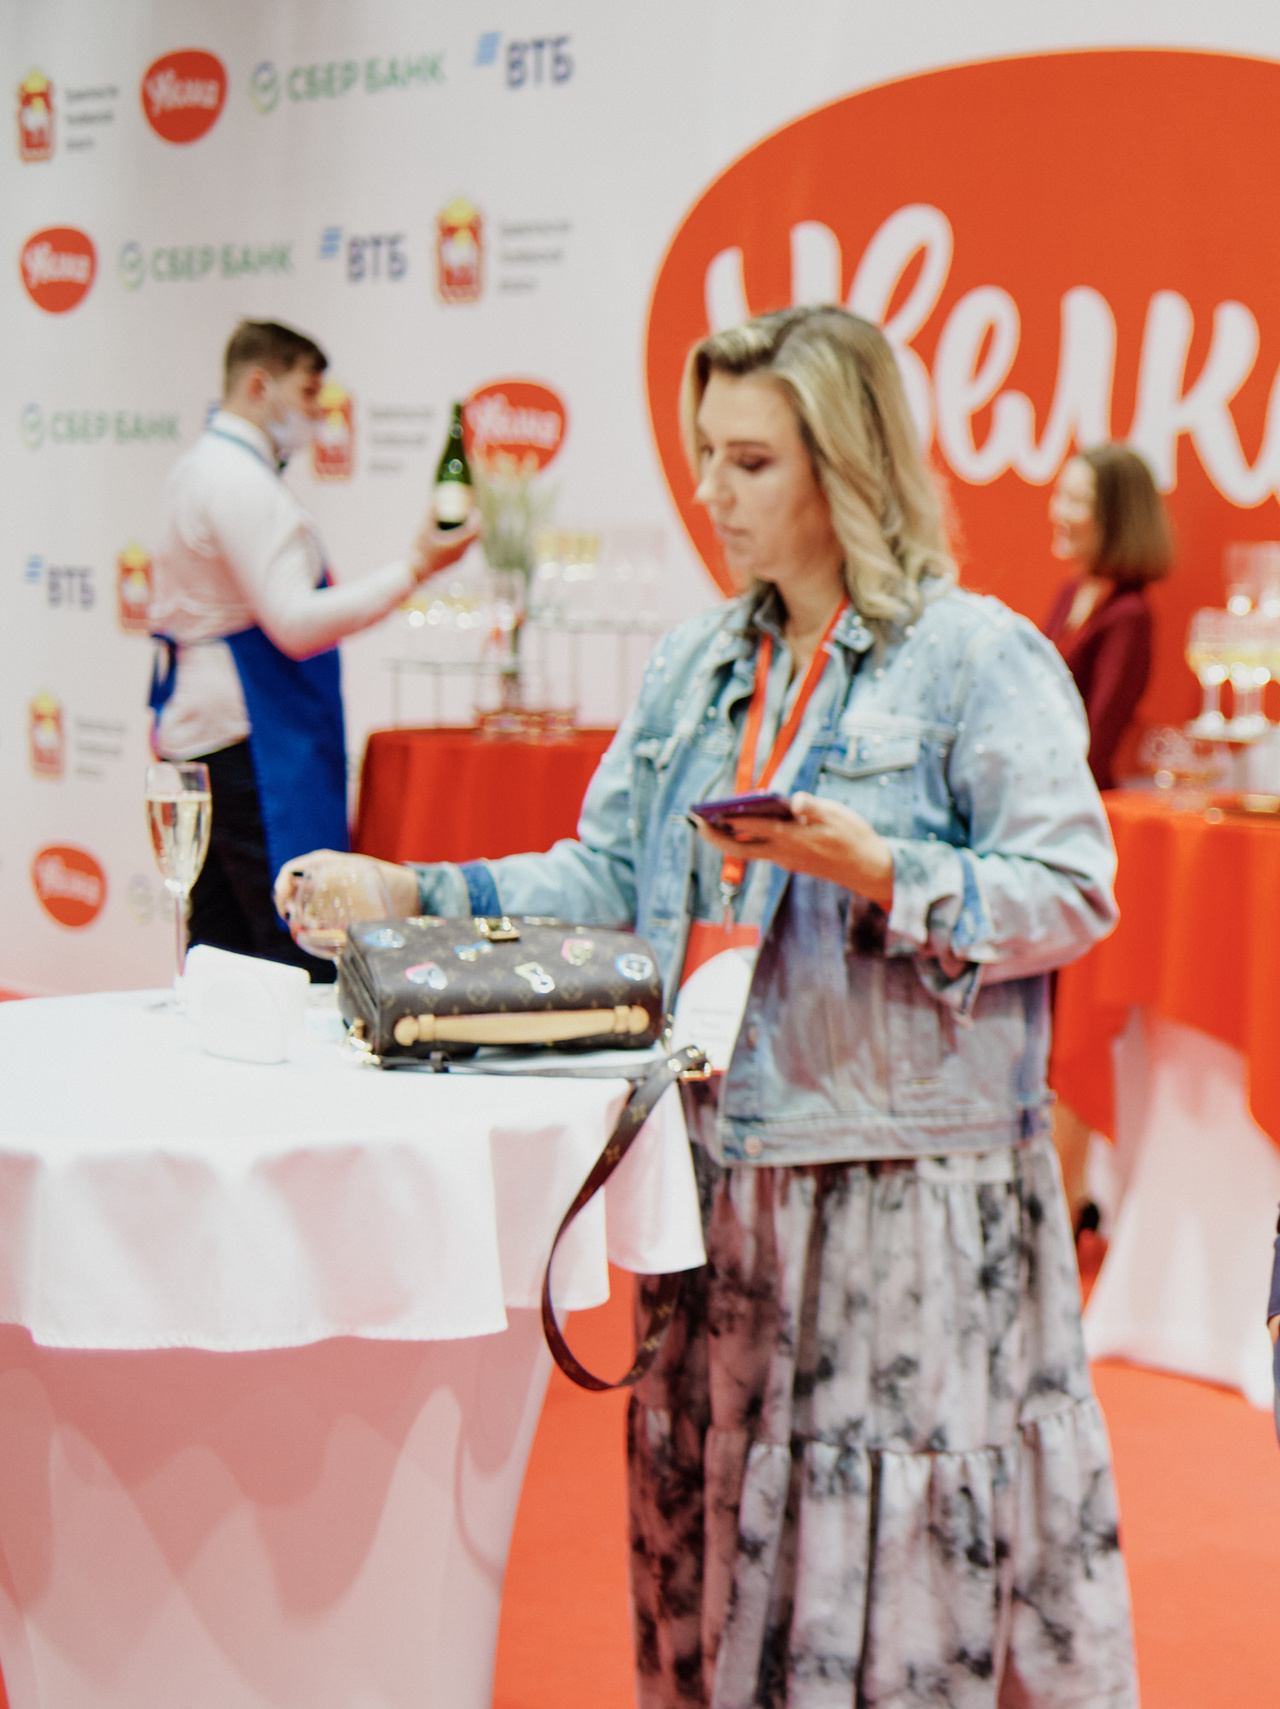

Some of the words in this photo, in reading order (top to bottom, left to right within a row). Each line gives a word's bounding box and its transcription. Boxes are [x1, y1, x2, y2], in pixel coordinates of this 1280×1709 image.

[286, 62, 358, 103] СБЕР
[364, 52, 446, 94] БАНК
[506, 34, 572, 91] ВТБ
[347, 233, 409, 284] ВТБ
